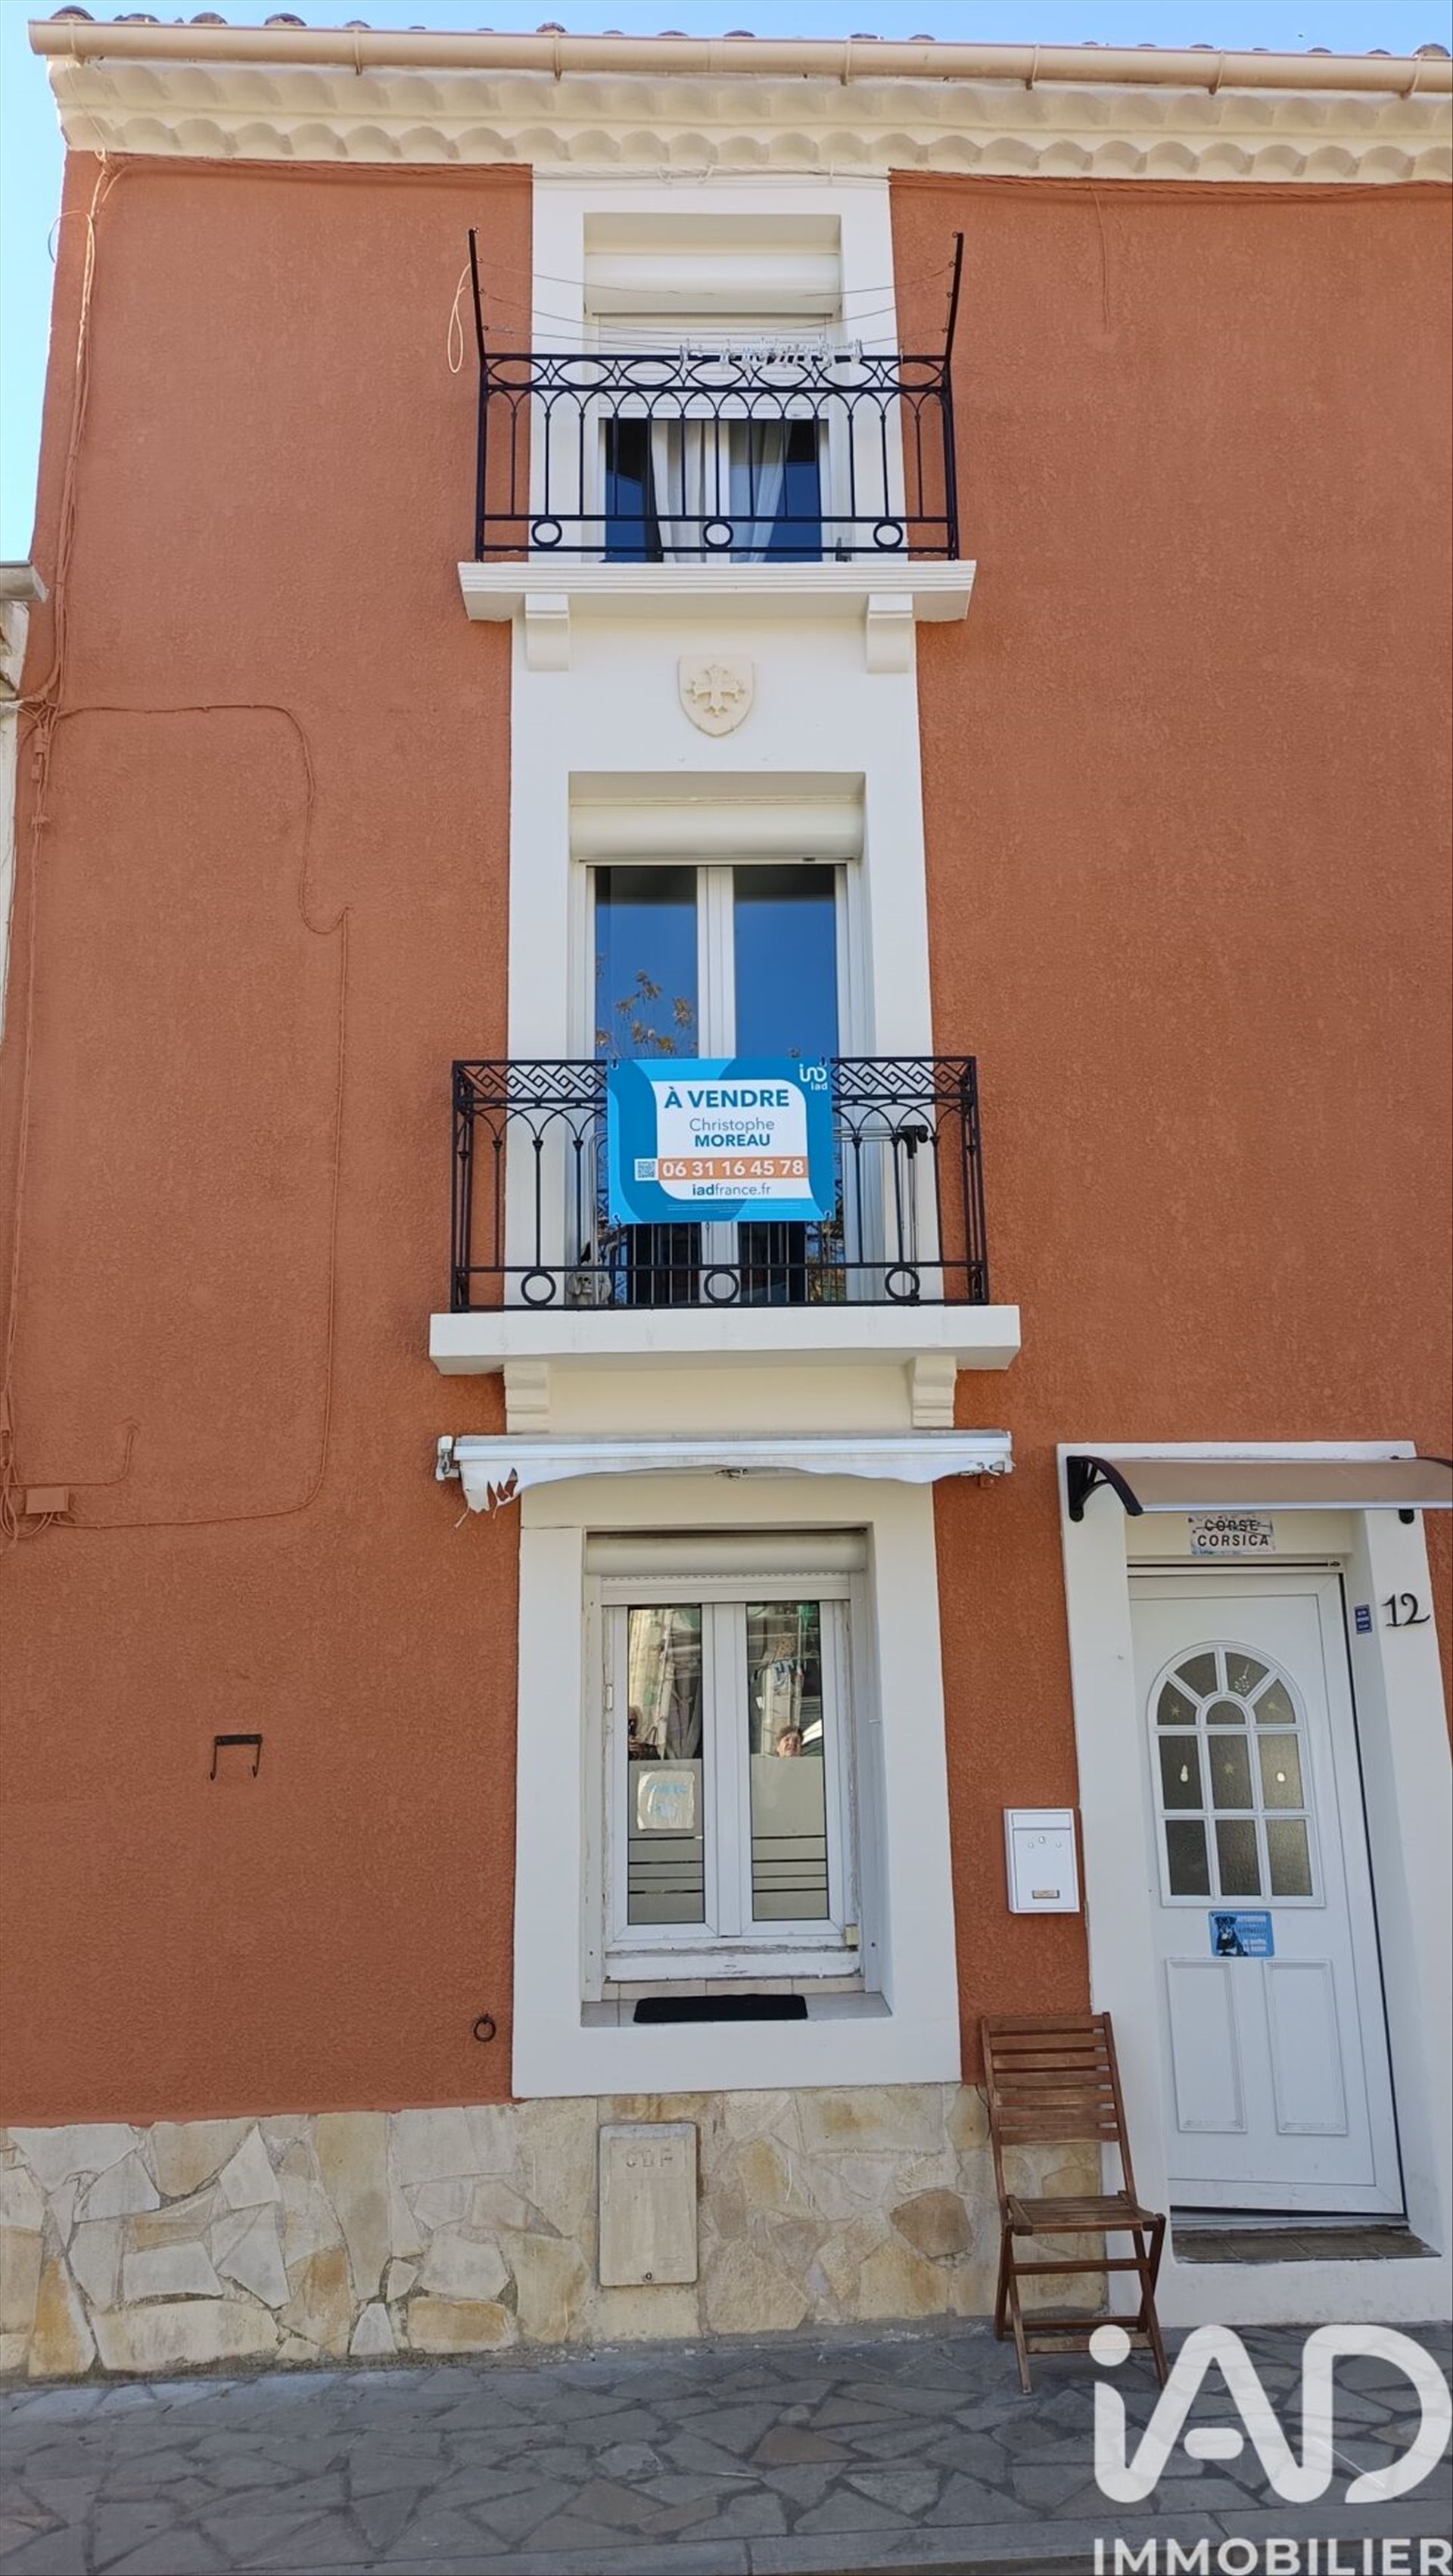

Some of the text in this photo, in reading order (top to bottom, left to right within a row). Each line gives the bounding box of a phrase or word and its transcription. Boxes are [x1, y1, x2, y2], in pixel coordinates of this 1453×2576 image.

[664, 1086, 790, 1109] À VENDRE
[689, 1117, 775, 1134] Christophe
[695, 1134, 770, 1147] MOREAU
[662, 1159, 804, 1177] 06 31 16 45 78
[692, 1183, 771, 1196] iadfrance.fr
[1205, 1520, 1258, 1532] CORSE
[1197, 1535, 1269, 1547] CORSICA
[1381, 1592, 1431, 1628] 12
